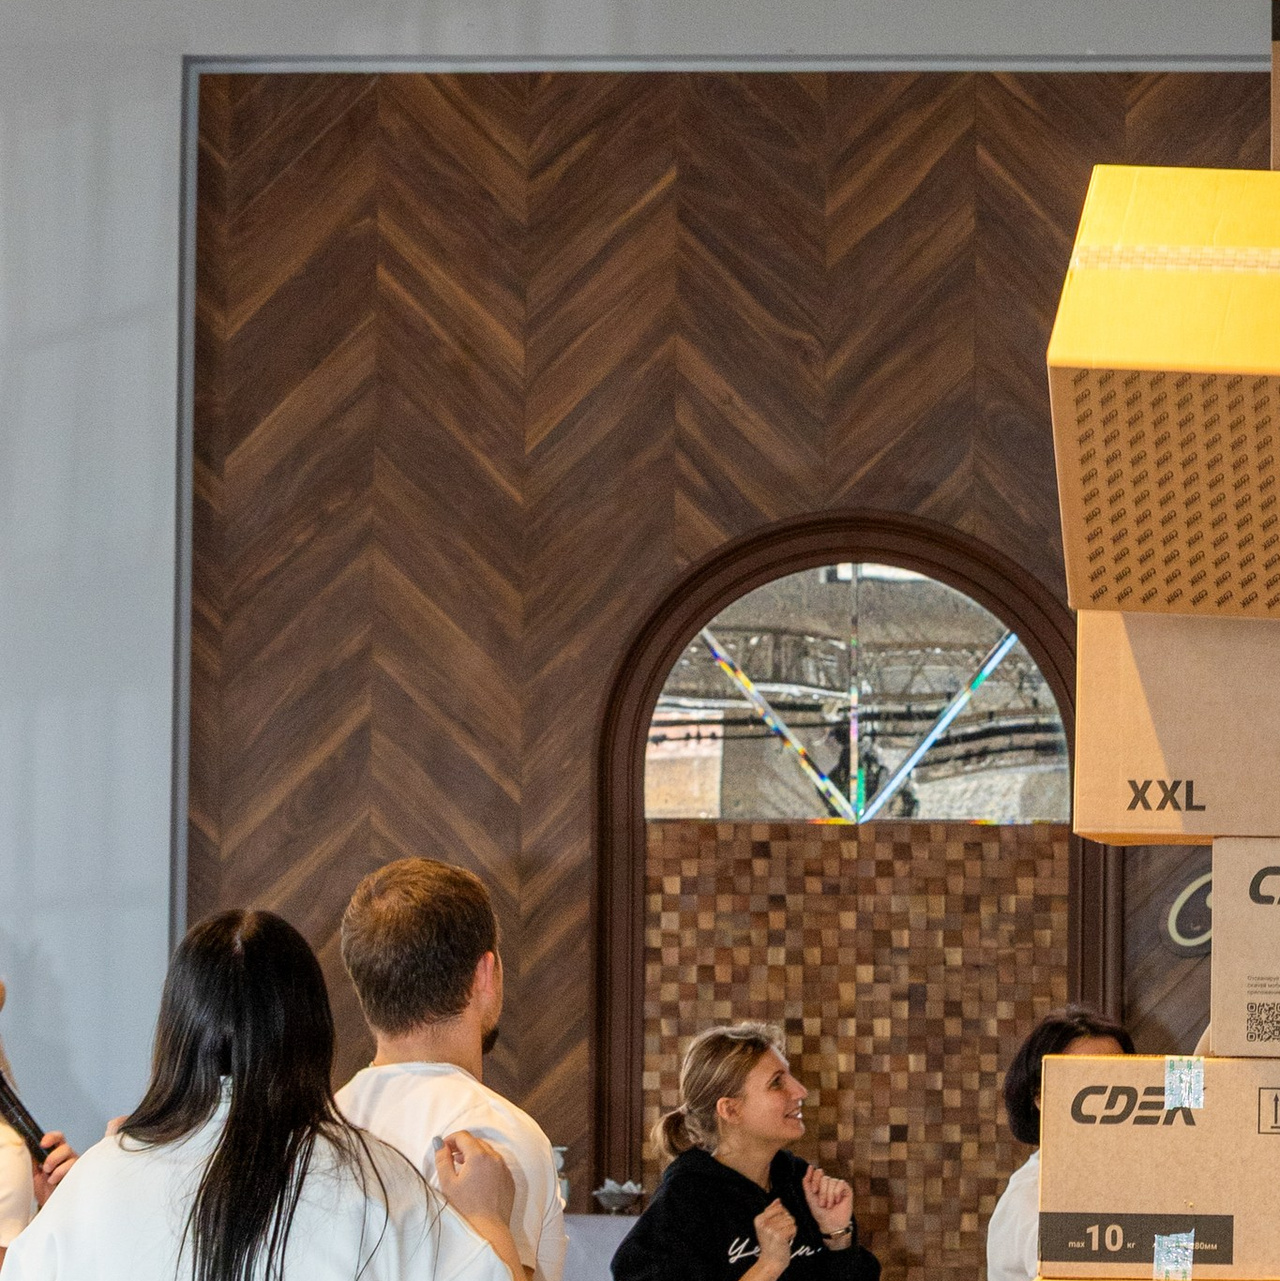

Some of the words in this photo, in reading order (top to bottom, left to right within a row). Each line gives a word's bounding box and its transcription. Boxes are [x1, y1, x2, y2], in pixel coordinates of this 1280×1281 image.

[1128, 780, 1206, 811] XXL
[1068, 1240, 1085, 1248] max
[1085, 1224, 1124, 1252] 10
